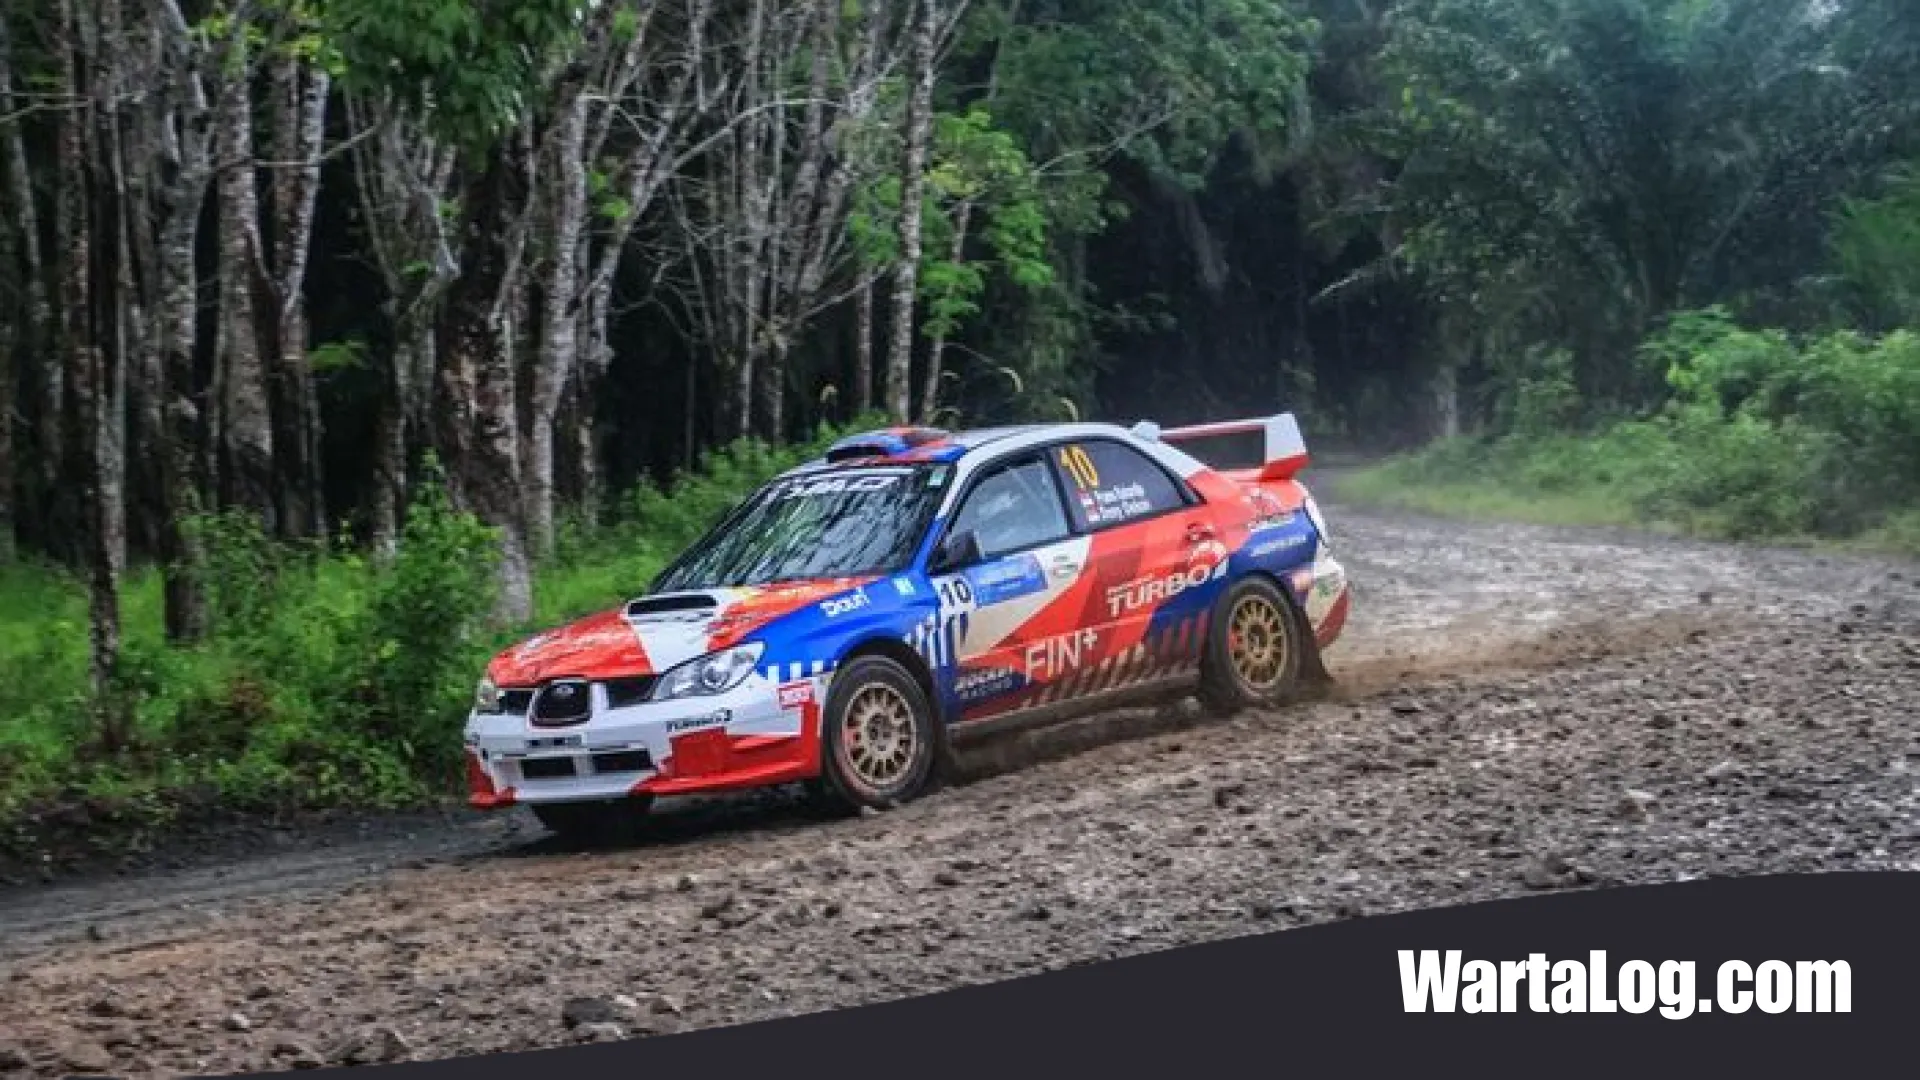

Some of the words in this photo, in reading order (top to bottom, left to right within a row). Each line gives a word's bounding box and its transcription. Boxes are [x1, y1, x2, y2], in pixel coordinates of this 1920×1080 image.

[1060, 445, 1098, 488] 10
[941, 577, 971, 607] 10
[1107, 565, 1212, 617] TURBO
